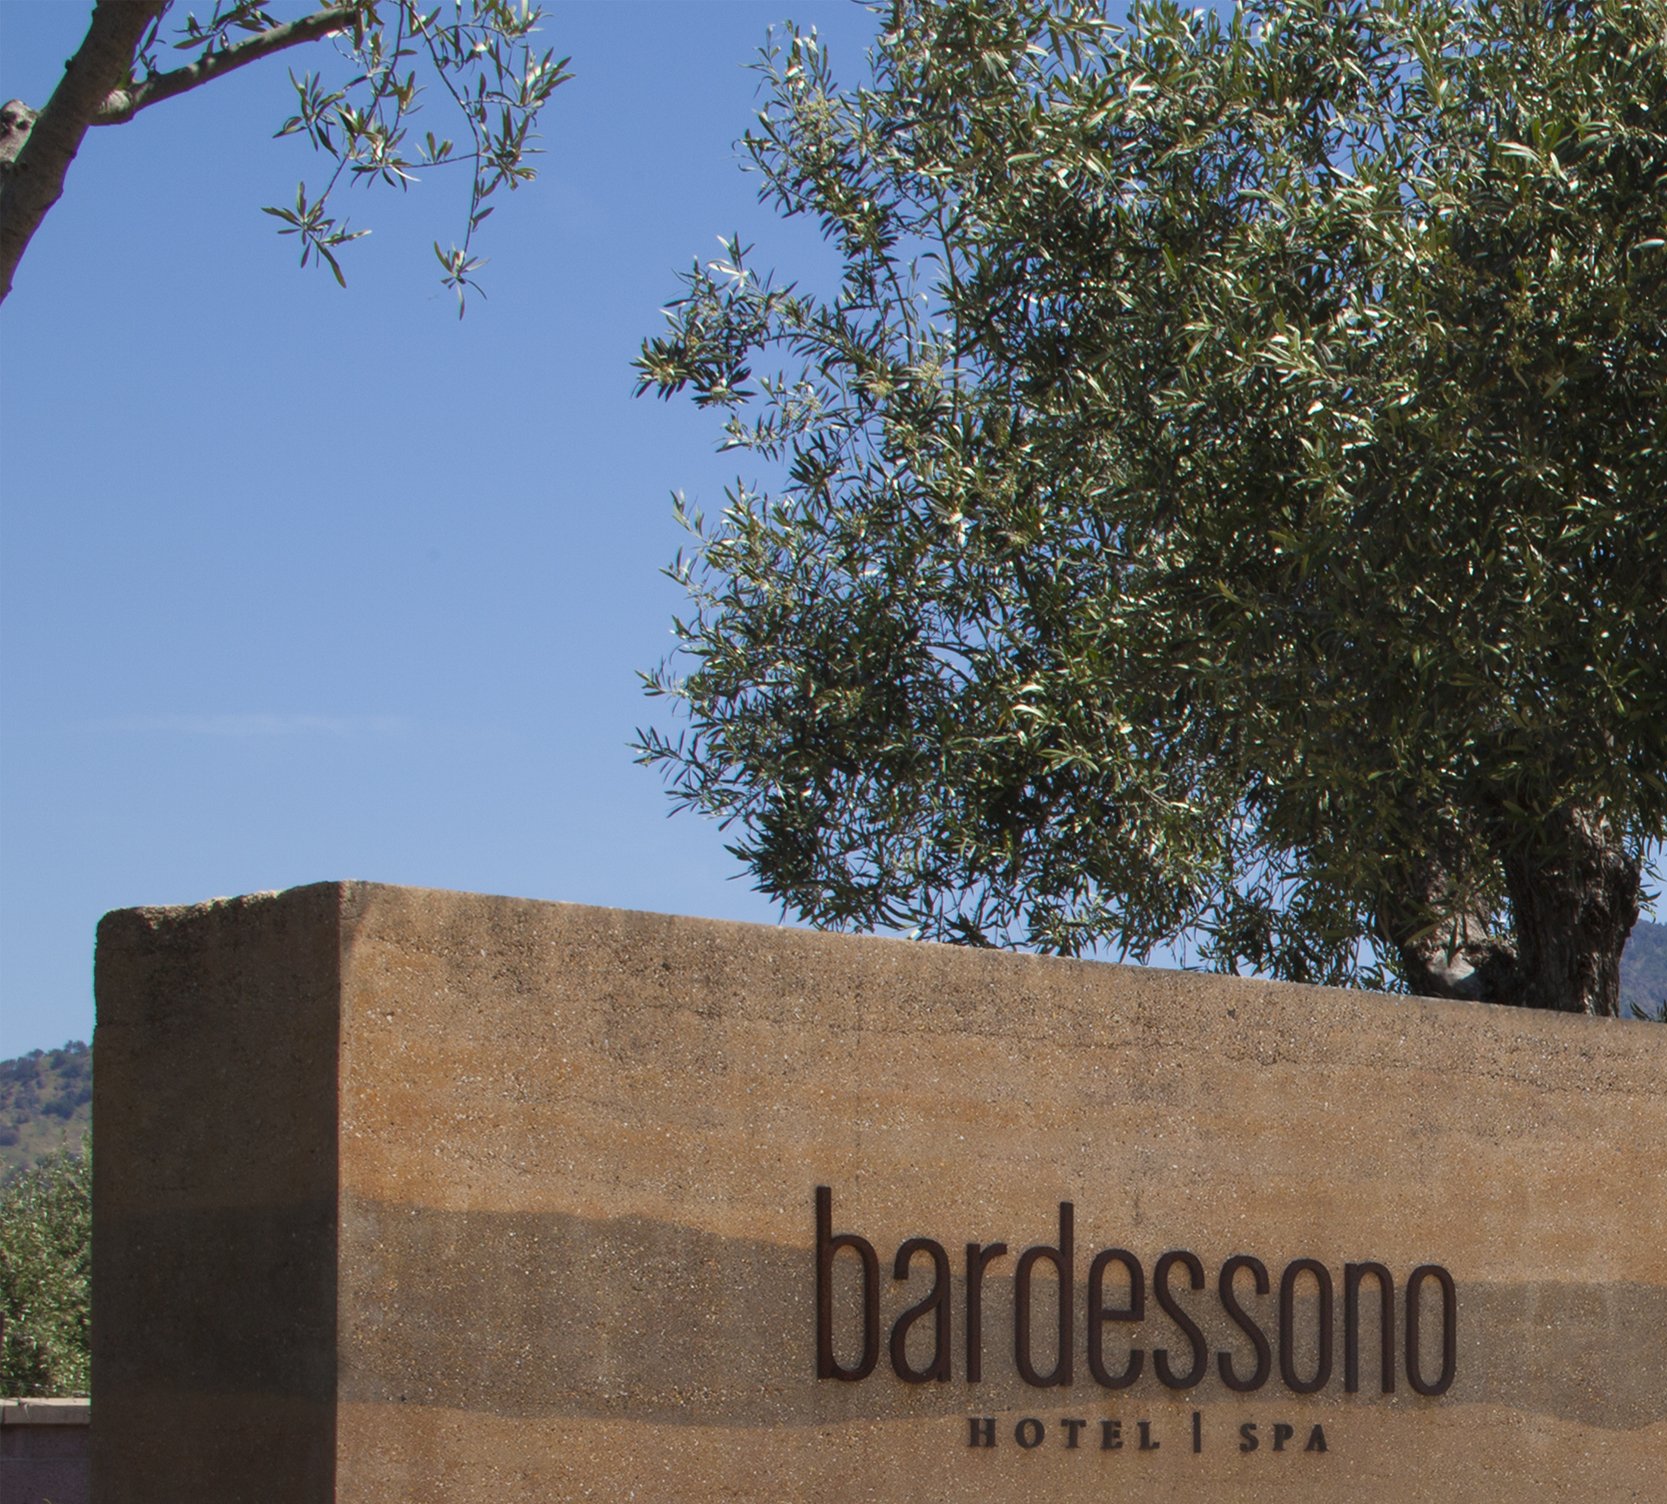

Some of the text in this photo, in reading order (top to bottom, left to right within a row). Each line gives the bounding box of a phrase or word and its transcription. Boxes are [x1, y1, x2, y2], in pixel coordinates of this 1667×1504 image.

[816, 1186, 1457, 1396] bardessono
[967, 1418, 1330, 1453] HOTEL SPA
